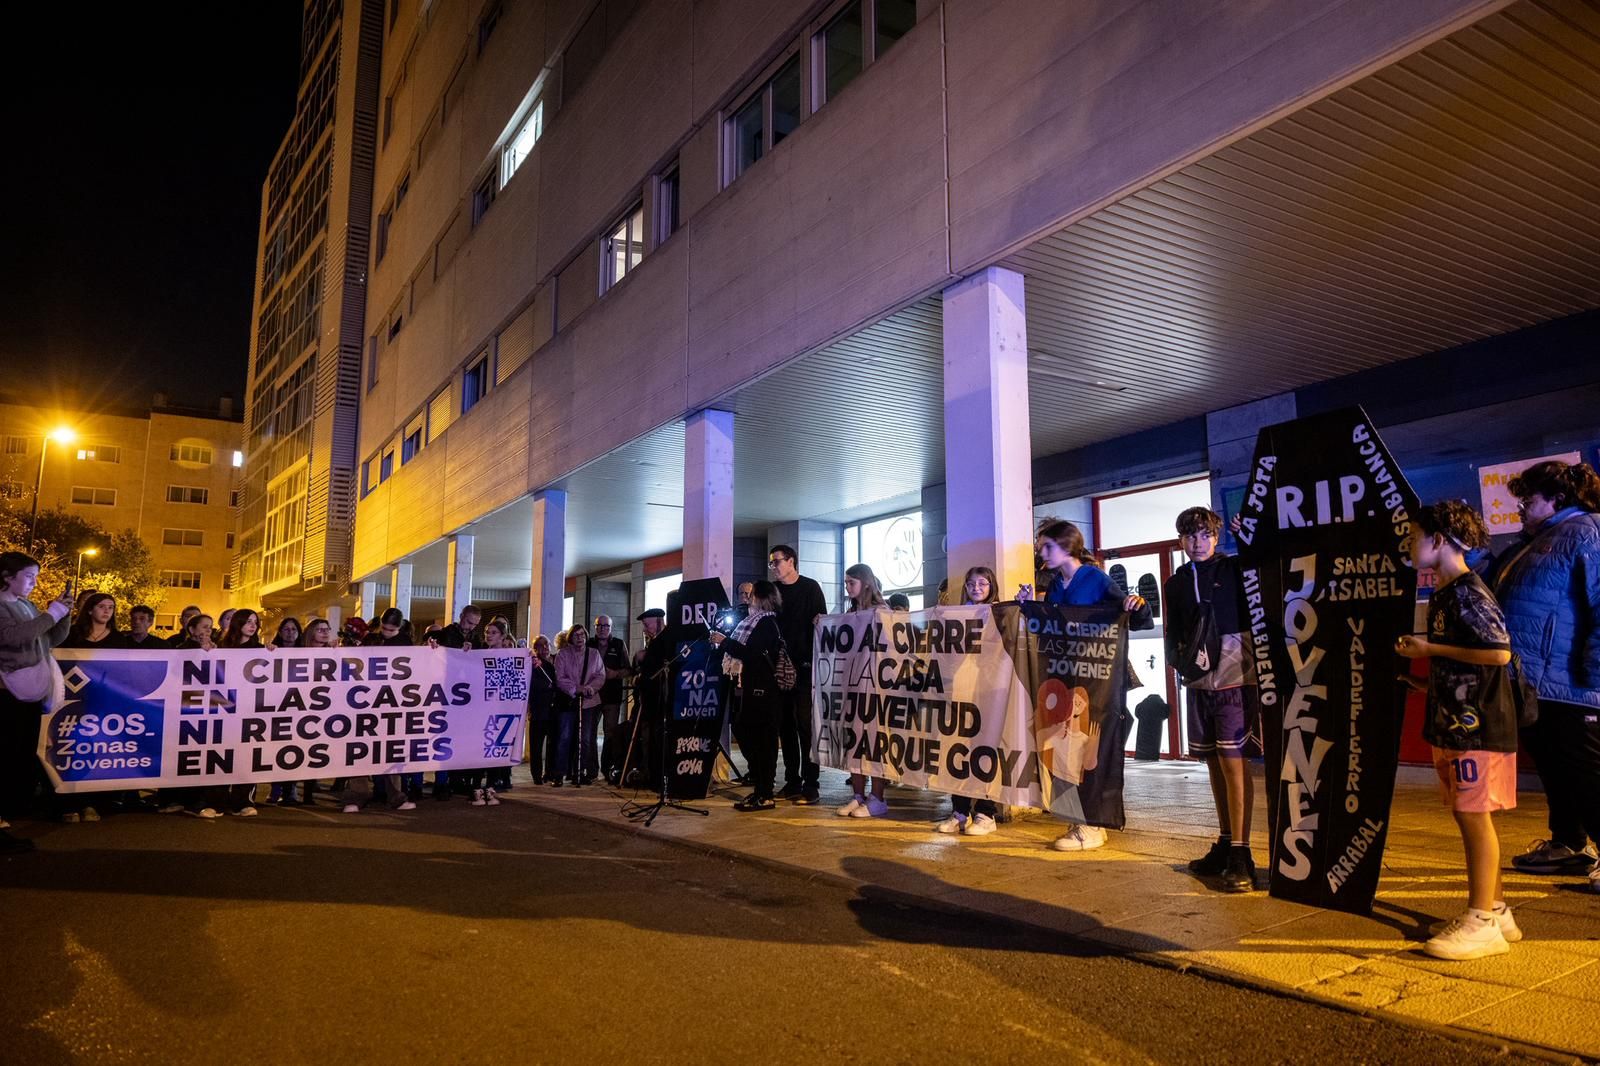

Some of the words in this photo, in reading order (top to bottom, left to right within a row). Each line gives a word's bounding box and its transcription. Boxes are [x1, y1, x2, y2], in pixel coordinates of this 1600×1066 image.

[1248, 456, 1277, 512] JOTA
[1276, 475, 1375, 529] R.I.P.
[1239, 517, 1258, 545] LA
[1333, 553, 1396, 575] SANTA
[1329, 577, 1403, 601] ISABEL
[820, 624, 854, 653] NO
[857, 622, 888, 653] AL
[892, 619, 984, 654] CIERRE
[1042, 620, 1063, 636] AL
[1066, 621, 1119, 639] CIERRE
[1243, 568, 1277, 706] MIRALBUENO
[1037, 638, 1064, 655] LAS
[1066, 641, 1117, 660] ZONAS
[183, 660, 226, 685] NI
[243, 656, 412, 684] CIERRES
[818, 657, 847, 687] DE
[848, 658, 876, 688] LA
[878, 658, 944, 694] CASA
[1046, 656, 1113, 680] JÓVENES
[181, 688, 237, 715] EN
[255, 686, 331, 713] LAS
[346, 682, 471, 709] CASAS
[688, 688, 719, 706] NA
[680, 707, 716, 717] Joven
[821, 691, 841, 722] DE
[844, 692, 981, 738] JUVENTUD
[1345, 617, 1365, 813] VALDEFIERRO
[178, 719, 223, 745] NI
[241, 710, 448, 743] RECORTES
[56, 739, 138, 755] Zonas
[177, 749, 234, 776] EN
[252, 743, 330, 772] LOS
[345, 737, 453, 766] PIEES
[484, 747, 509, 758] ZGZ
[817, 724, 842, 755] EN
[843, 727, 941, 776] PARQUE
[946, 743, 1042, 788] GOYA
[56, 756, 152, 771] Jovenes
[676, 758, 703, 775] GOYA
[1452, 758, 1478, 783] 10
[1327, 817, 1384, 894] ARRABAL
